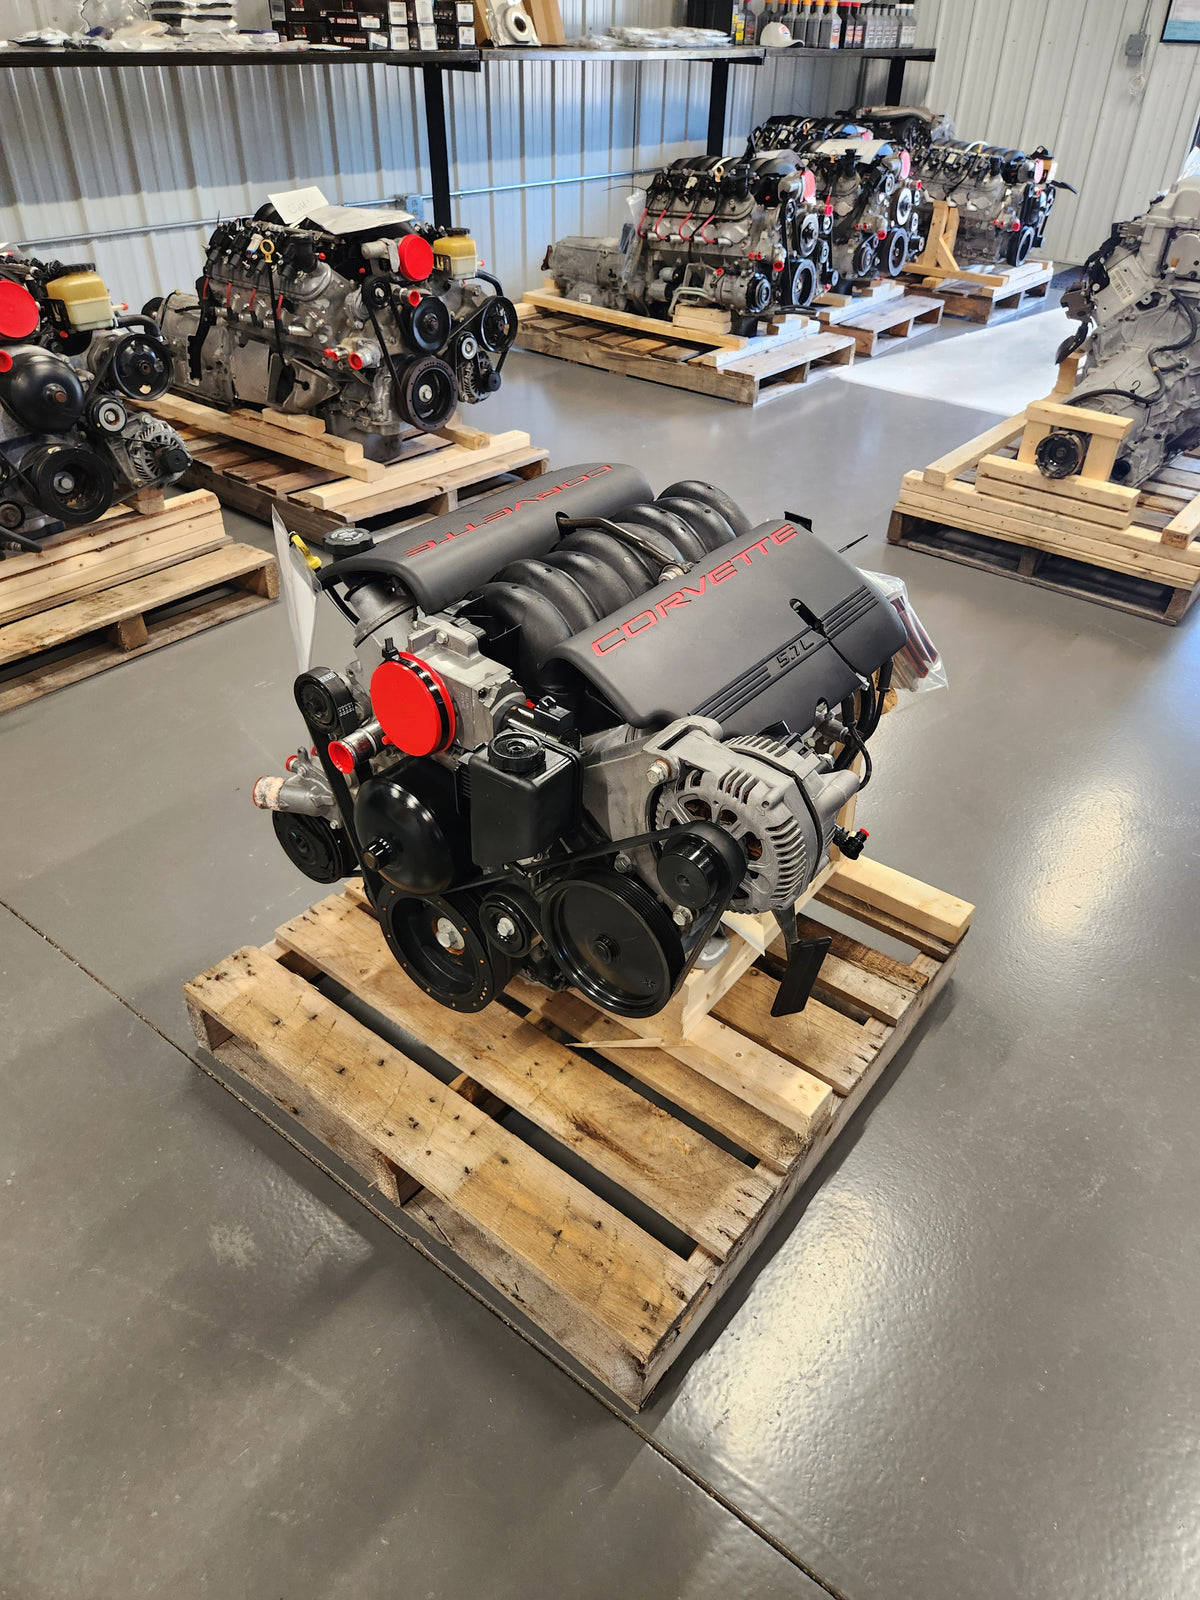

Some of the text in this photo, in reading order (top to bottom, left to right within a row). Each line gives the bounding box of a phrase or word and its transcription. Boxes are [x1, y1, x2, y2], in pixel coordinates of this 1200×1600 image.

[404, 465, 612, 557] CORVETTE
[591, 523, 798, 657] CORVETTE
[776, 639, 815, 668] 5.7L
